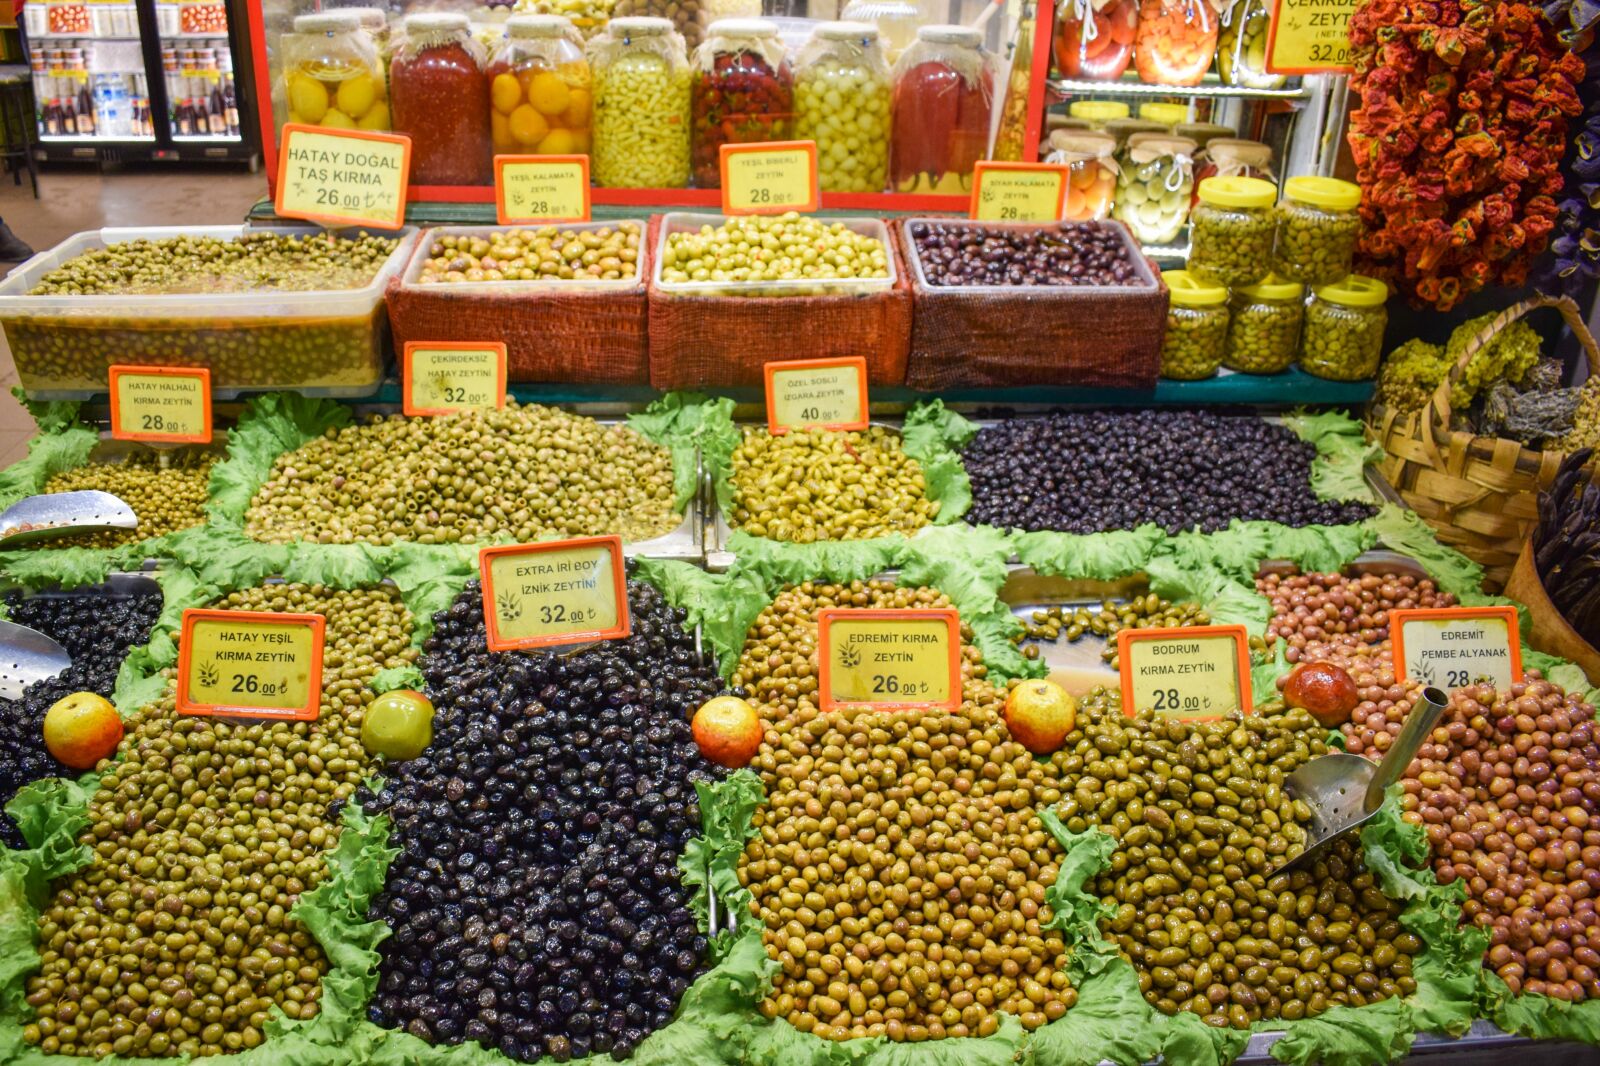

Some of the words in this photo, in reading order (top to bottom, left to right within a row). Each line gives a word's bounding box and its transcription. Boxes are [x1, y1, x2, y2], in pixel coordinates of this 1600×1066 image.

[1309, 13, 1353, 26] ZEYT
[288, 148, 340, 164] HATAY
[345, 152, 399, 169] DOĞAL
[298, 166, 328, 184] TAŞ
[333, 170, 382, 186] KIRMA
[533, 172, 575, 180] KALAMATA
[530, 185, 557, 193] ZEYTİN
[1014, 180, 1055, 188] KALAMATA
[316, 188, 360, 210] 26.00
[1003, 192, 1030, 200] ZEYTİN
[430, 355, 488, 364] ÇEKİRDEKSİZ
[428, 370, 457, 378] HATAY
[160, 383, 196, 392] HALHALİ
[787, 380, 808, 388] ÖZEL
[133, 396, 160, 405] KIRMA
[162, 397, 193, 406] ZEYTİN
[516, 566, 554, 577] EXTRA
[556, 561, 571, 572] İRİ
[574, 560, 598, 571] BOY
[521, 583, 552, 596] İZNİK
[554, 578, 597, 592] ZEYTİNİ
[540, 604, 585, 624] 32.00
[220, 632, 260, 642] HATAY
[262, 632, 294, 646] YEŞİL
[849, 632, 900, 644] EDREMİT
[902, 634, 938, 643] KIRMA
[1441, 628, 1485, 640] EDREMİT
[1152, 644, 1200, 656] BODRUM
[1422, 649, 1457, 659] PEMBE
[1460, 648, 1507, 658] ALYANAK
[215, 651, 252, 662] KIRMA
[255, 650, 296, 663] ZEYTİN
[874, 651, 914, 662] ZEYTİN
[1140, 665, 1176, 676] KIRMA
[1177, 661, 1215, 674] ZEYTİN
[232, 674, 276, 696] 26.00
[872, 674, 917, 696] 26.00
[1447, 670, 1486, 688] 280
[1152, 688, 1200, 712] 28.00
